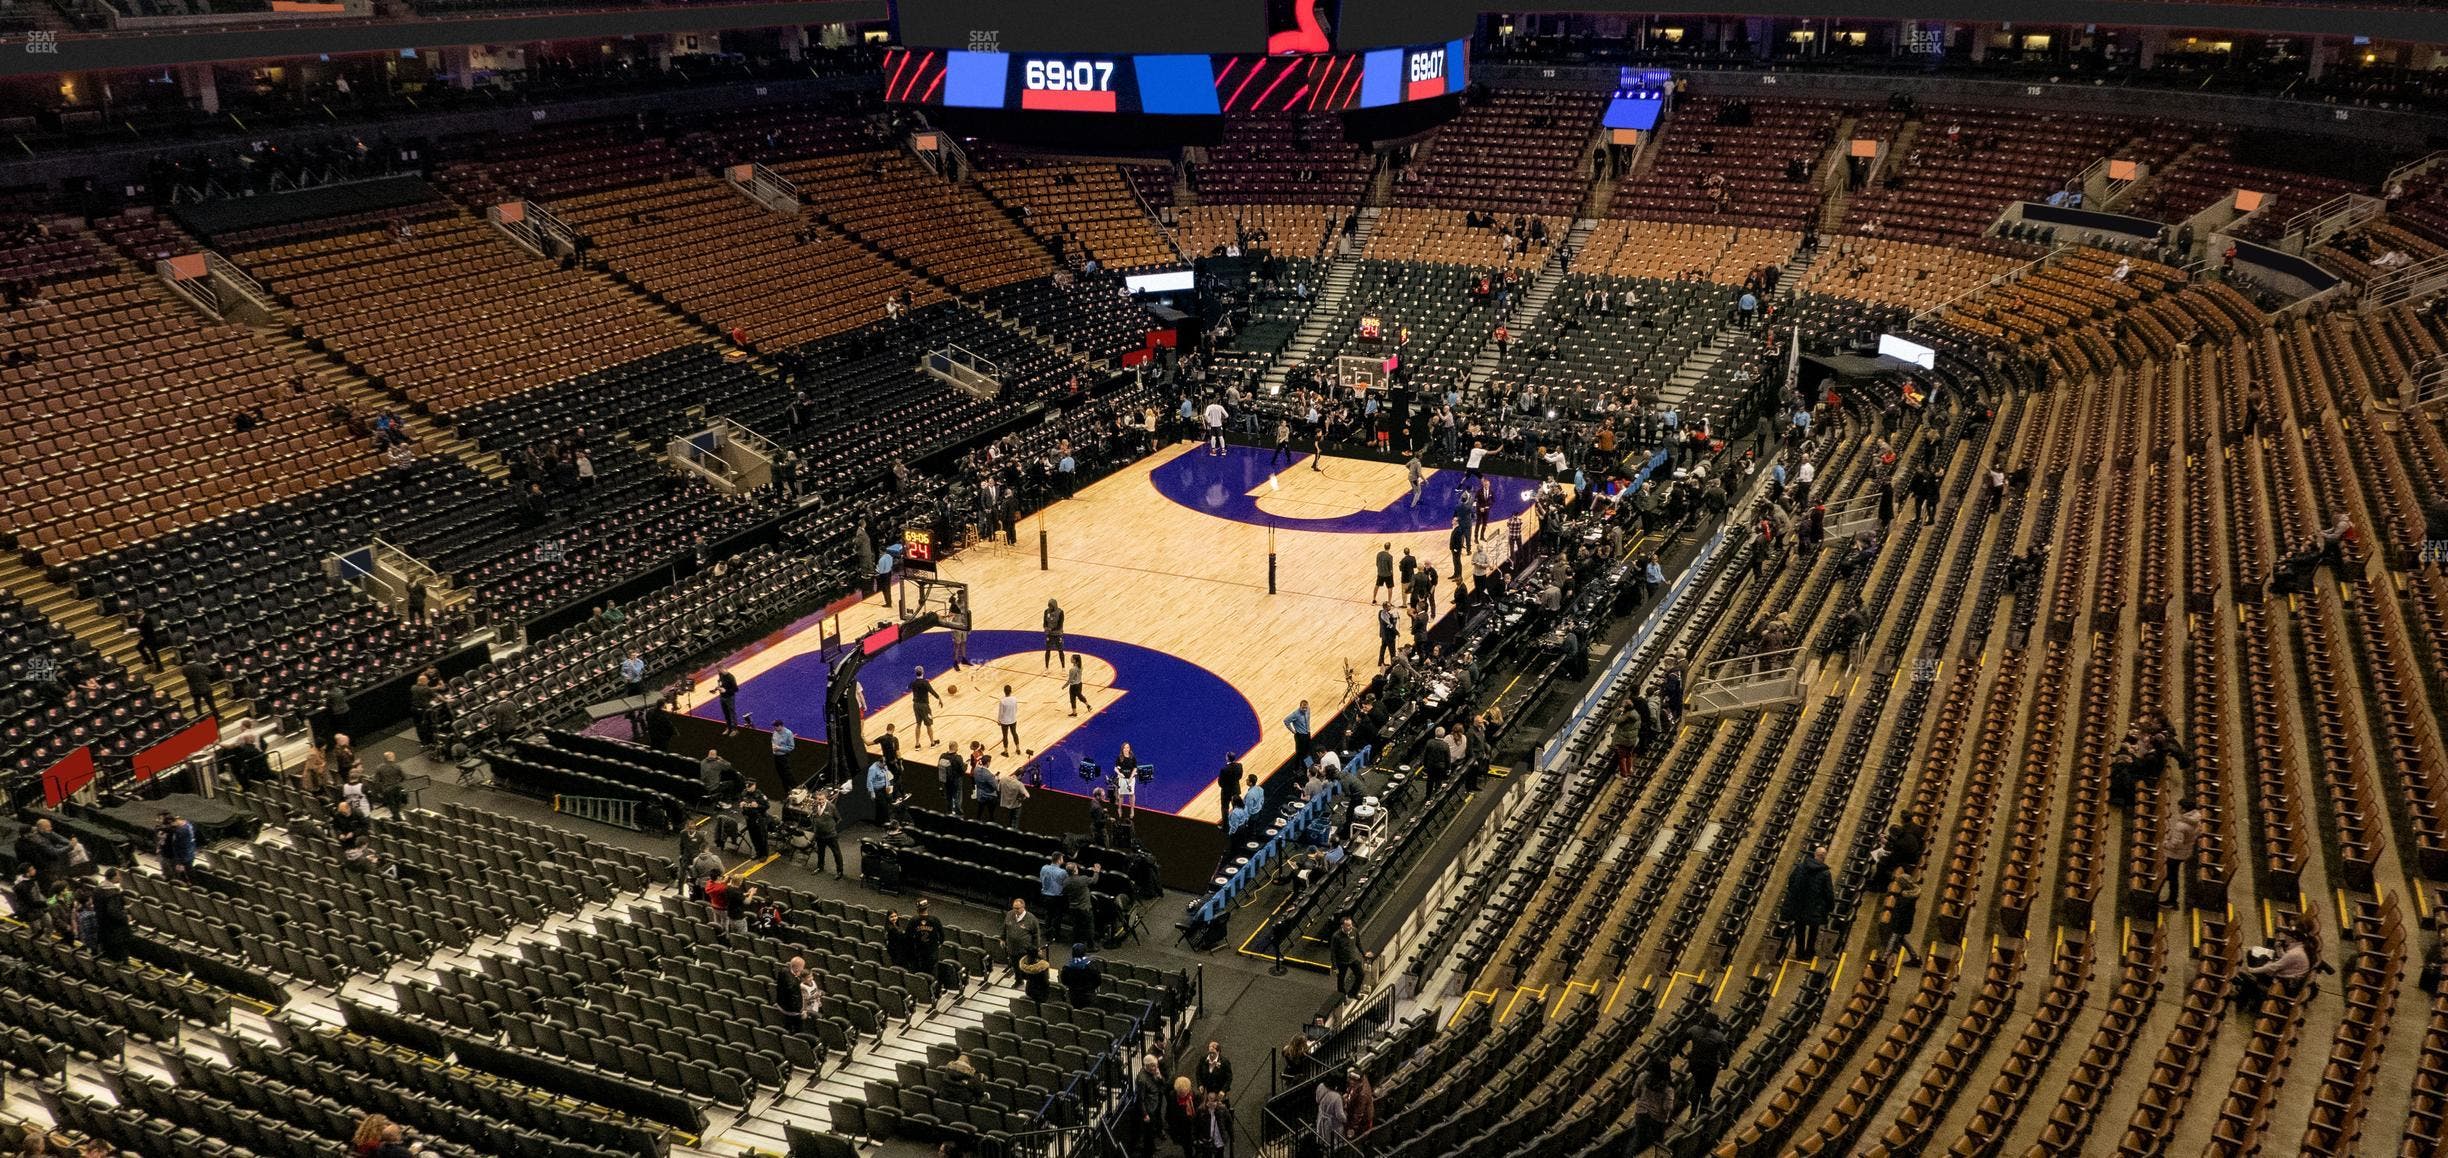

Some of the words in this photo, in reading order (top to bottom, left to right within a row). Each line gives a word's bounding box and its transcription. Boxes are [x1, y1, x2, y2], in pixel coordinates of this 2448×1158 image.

[1411, 50, 1444, 82] 69:07
[1026, 60, 1114, 92] 69:07
[1363, 326, 1378, 337] 24
[909, 542, 928, 559] 24
[764, 918, 771, 928] 2
